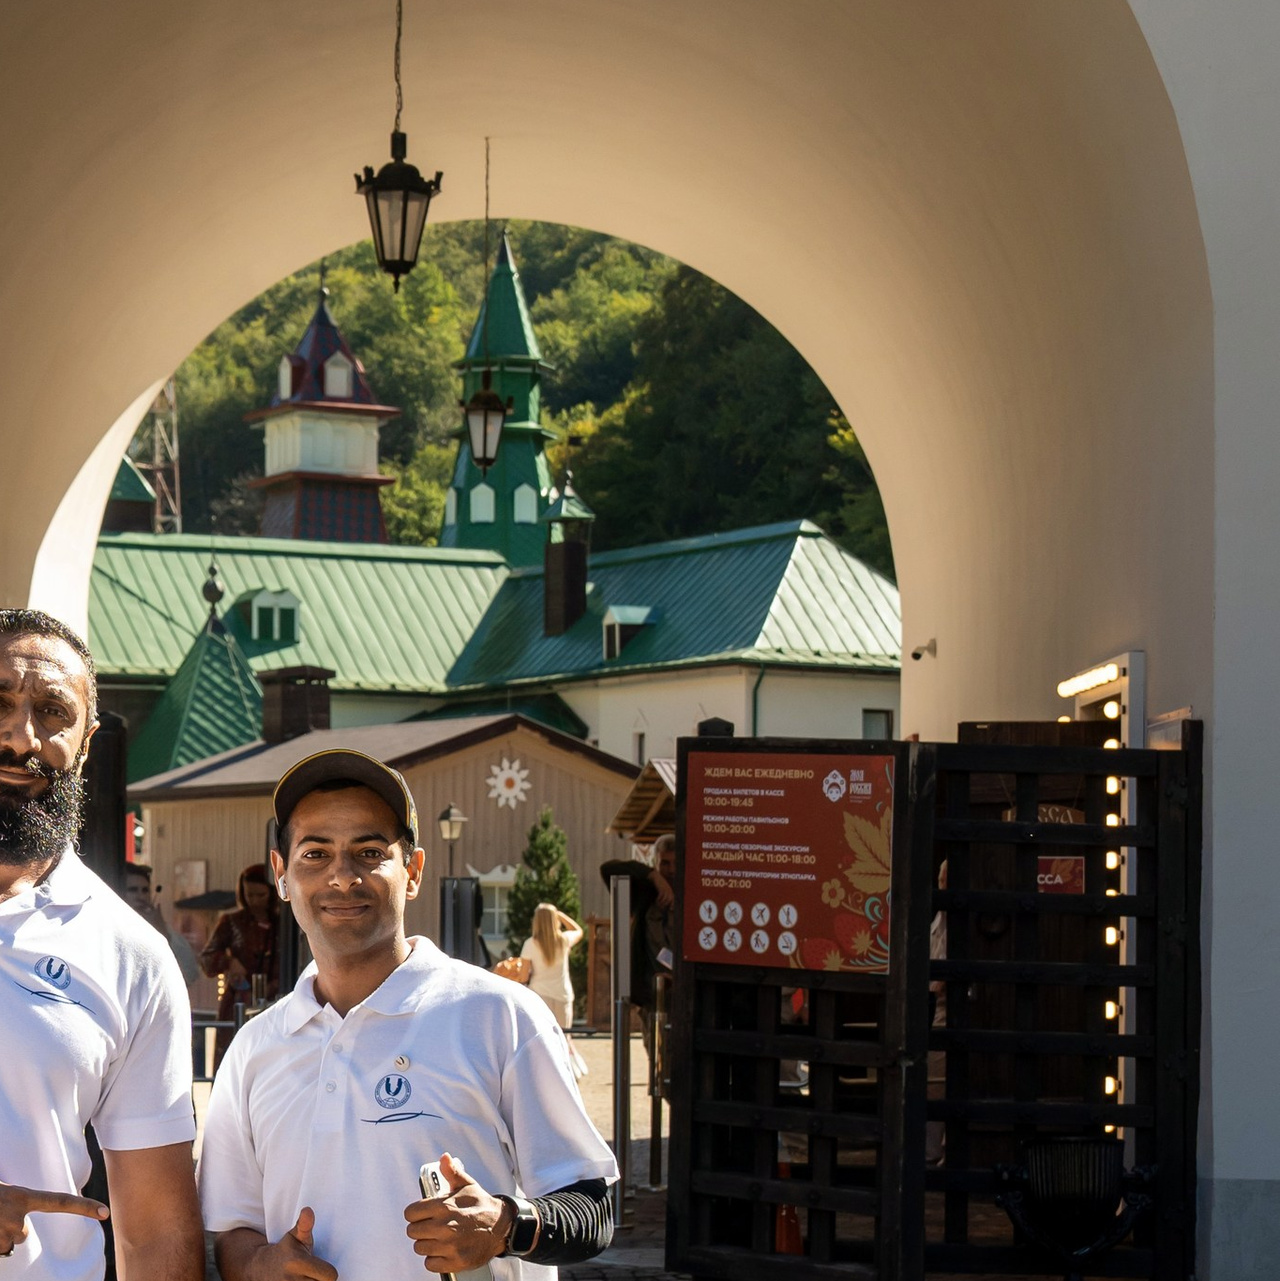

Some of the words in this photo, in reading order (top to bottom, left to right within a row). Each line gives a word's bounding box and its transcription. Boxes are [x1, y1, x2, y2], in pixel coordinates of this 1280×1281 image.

[704, 768, 732, 777] ЖДЕМ
[734, 768, 752, 777] ВАС
[754, 768, 814, 779] ЕЖЕДНЕВНО
[703, 797, 754, 807] 10:00-19:45
[702, 823, 756, 834] 10:00-20:00
[702, 850, 744, 861] КАЖДЫЙ
[745, 853, 764, 862] ЧАС
[766, 854, 816, 864] 11:00-18:00
[701, 877, 752, 888] 10:00-21:00
[1037, 874, 1063, 885] ССА
